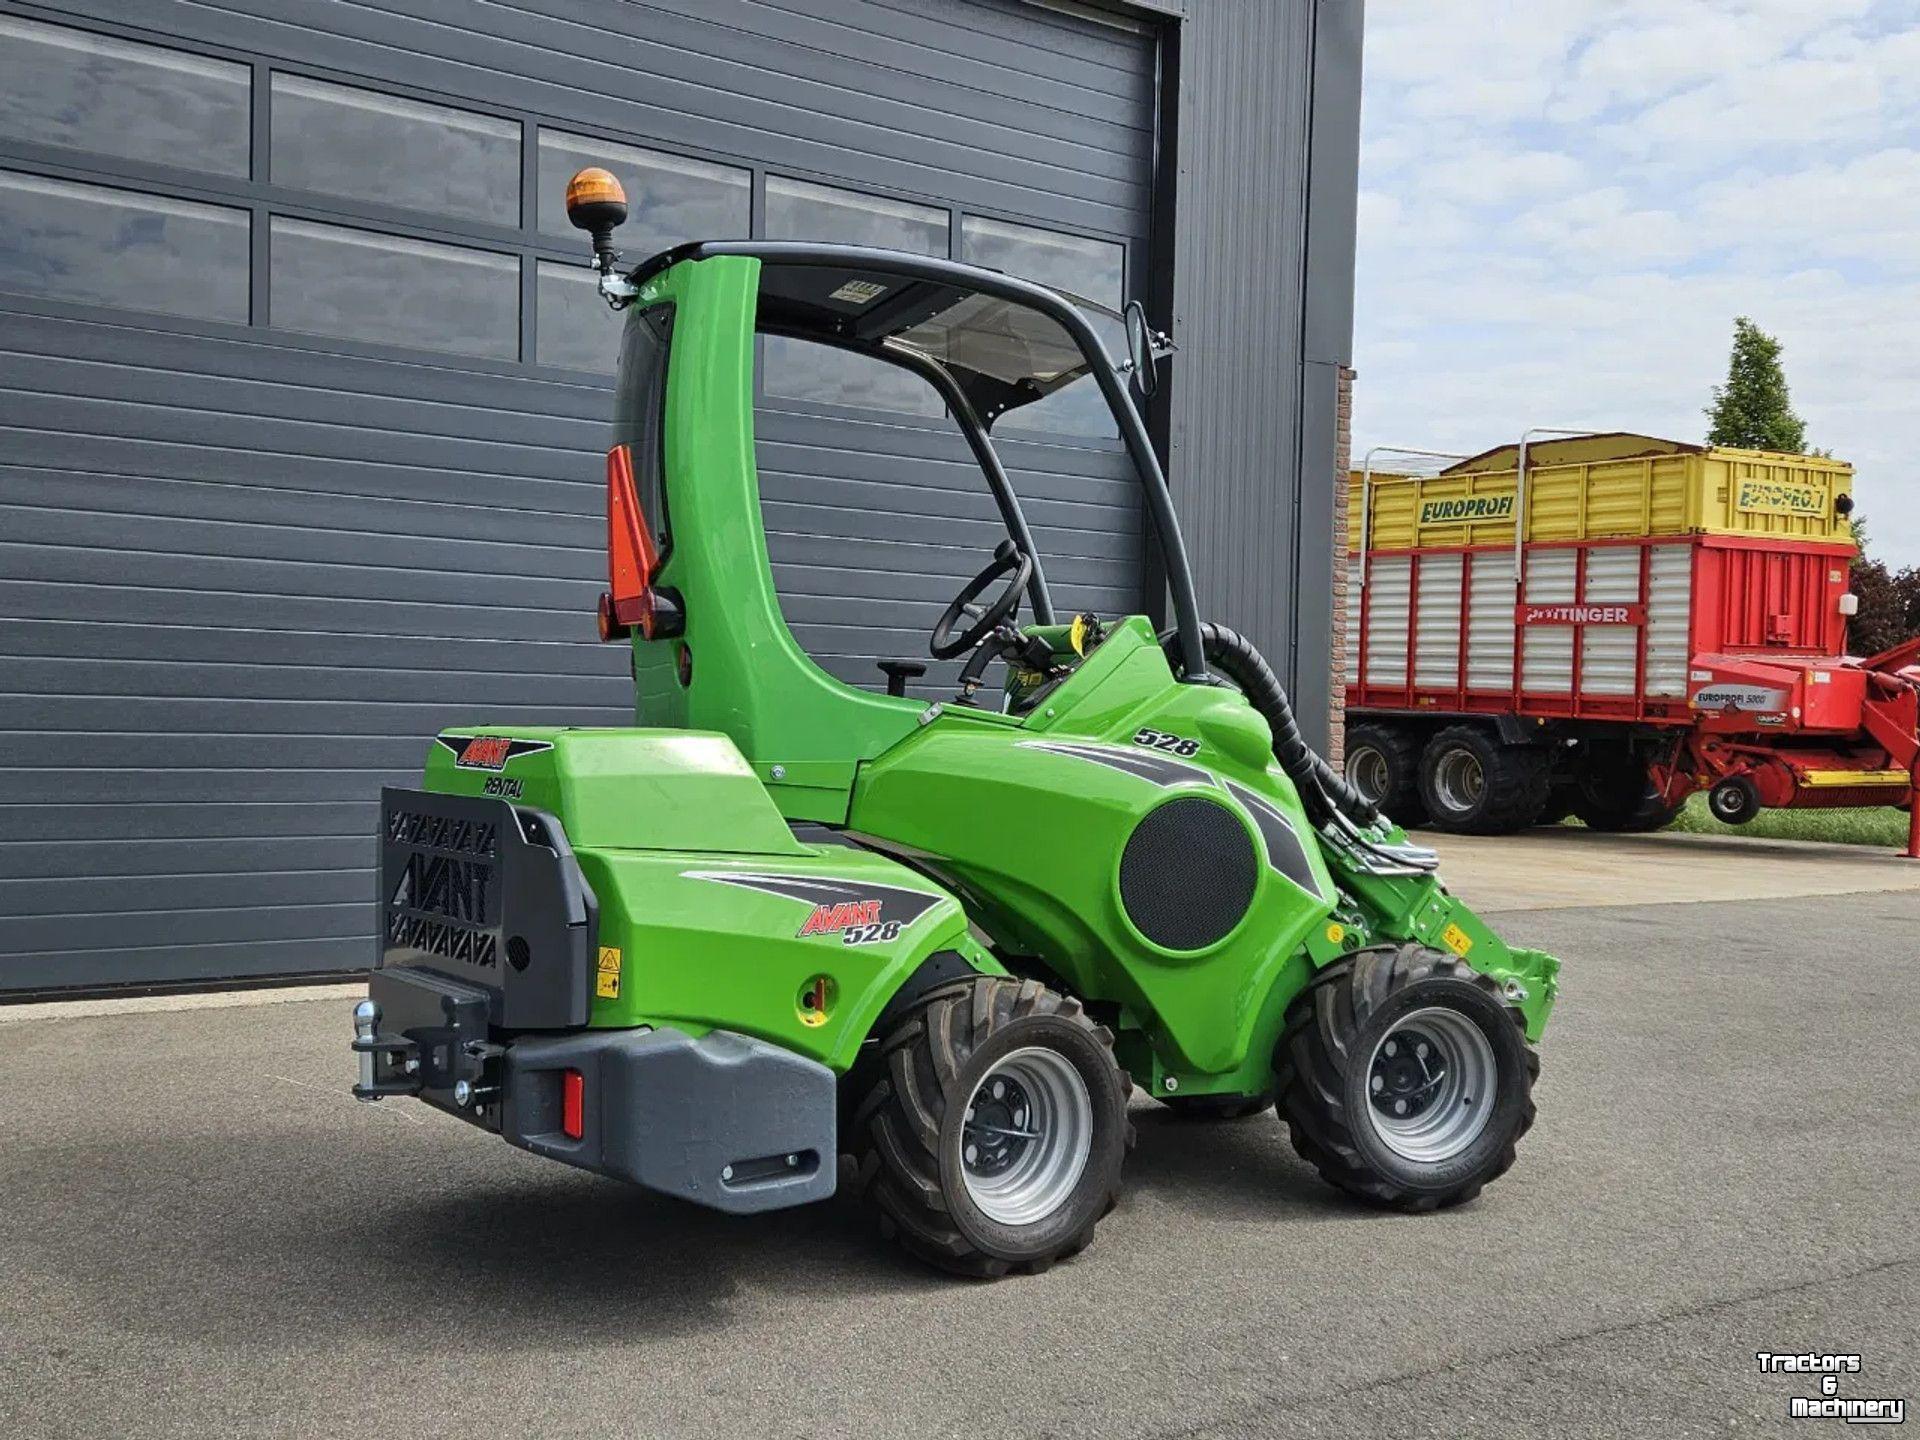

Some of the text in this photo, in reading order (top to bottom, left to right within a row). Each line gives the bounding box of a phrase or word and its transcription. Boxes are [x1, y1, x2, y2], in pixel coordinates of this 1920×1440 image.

[1421, 497, 1514, 523] EUROPROFI
[1698, 693, 1744, 704] EUROPROFI
[457, 737, 513, 768] AVANT
[1133, 727, 1202, 758] 528
[483, 777, 524, 798] RENTAL
[391, 852, 493, 924] AVANT
[797, 900, 882, 938] AVANT
[842, 921, 901, 946] 528
